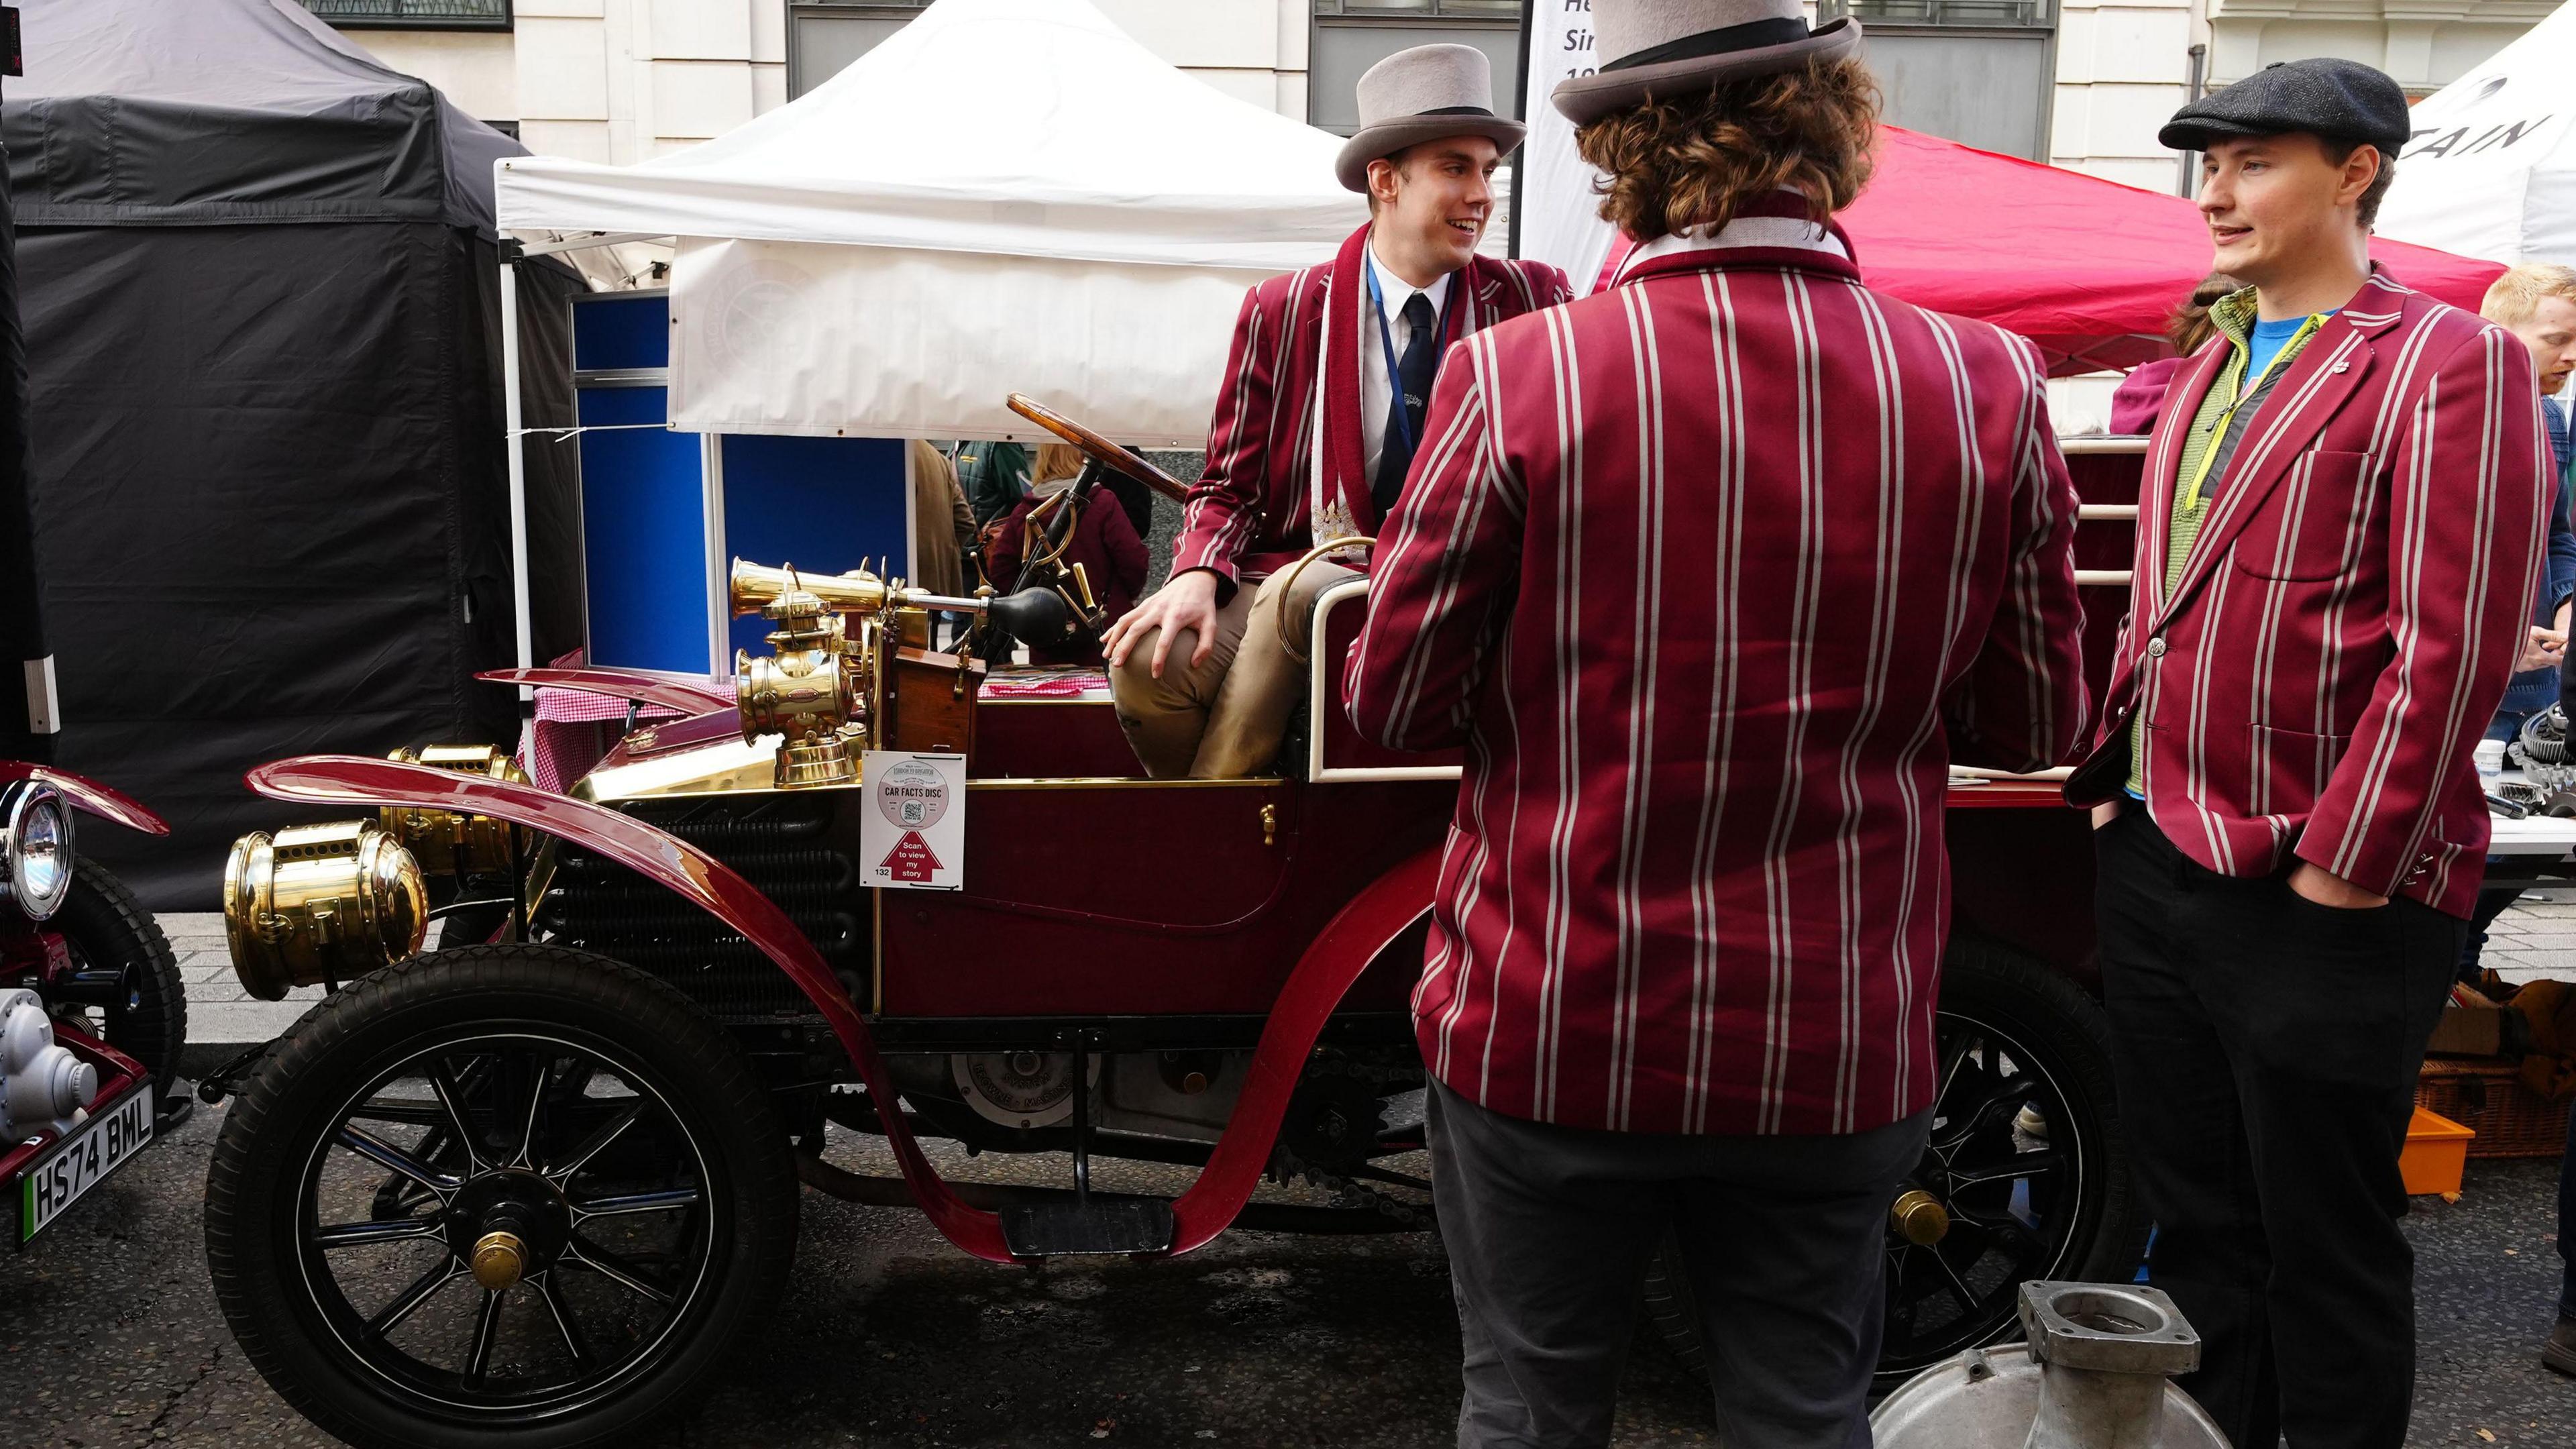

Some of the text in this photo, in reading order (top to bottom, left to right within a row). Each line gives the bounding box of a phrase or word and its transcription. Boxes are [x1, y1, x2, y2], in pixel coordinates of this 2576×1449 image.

[885, 787, 942, 798] CAR FACTS DISC
[902, 870, 922, 878] story
[36, 1097, 150, 1224] HS74 BML
